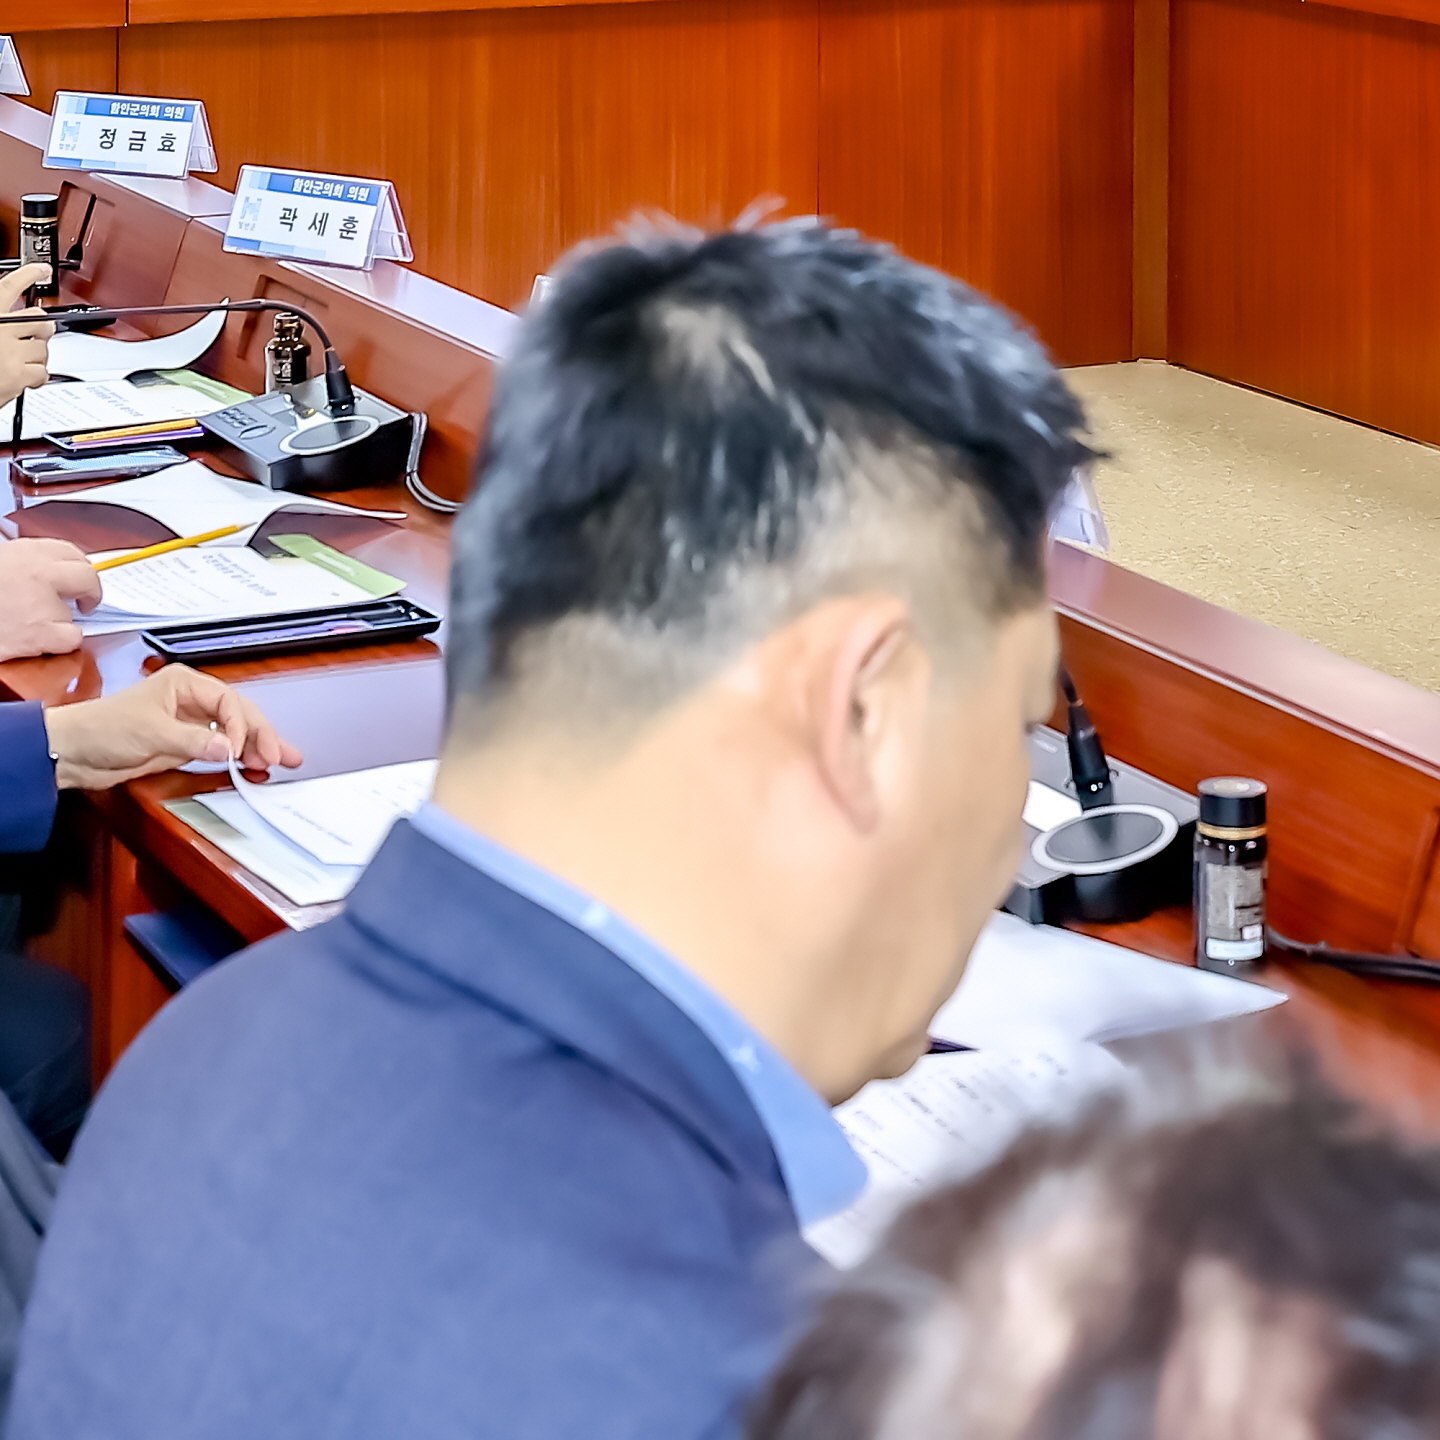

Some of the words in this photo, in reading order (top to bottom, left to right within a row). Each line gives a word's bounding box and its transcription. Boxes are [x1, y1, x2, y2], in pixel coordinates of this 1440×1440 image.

[110, 102, 161, 118] 함안군의회
[163, 106, 186, 120] 의원
[99, 128, 177, 153] 정금효
[292, 178, 345, 197] 함안군의회
[346, 185, 371, 202] 의원
